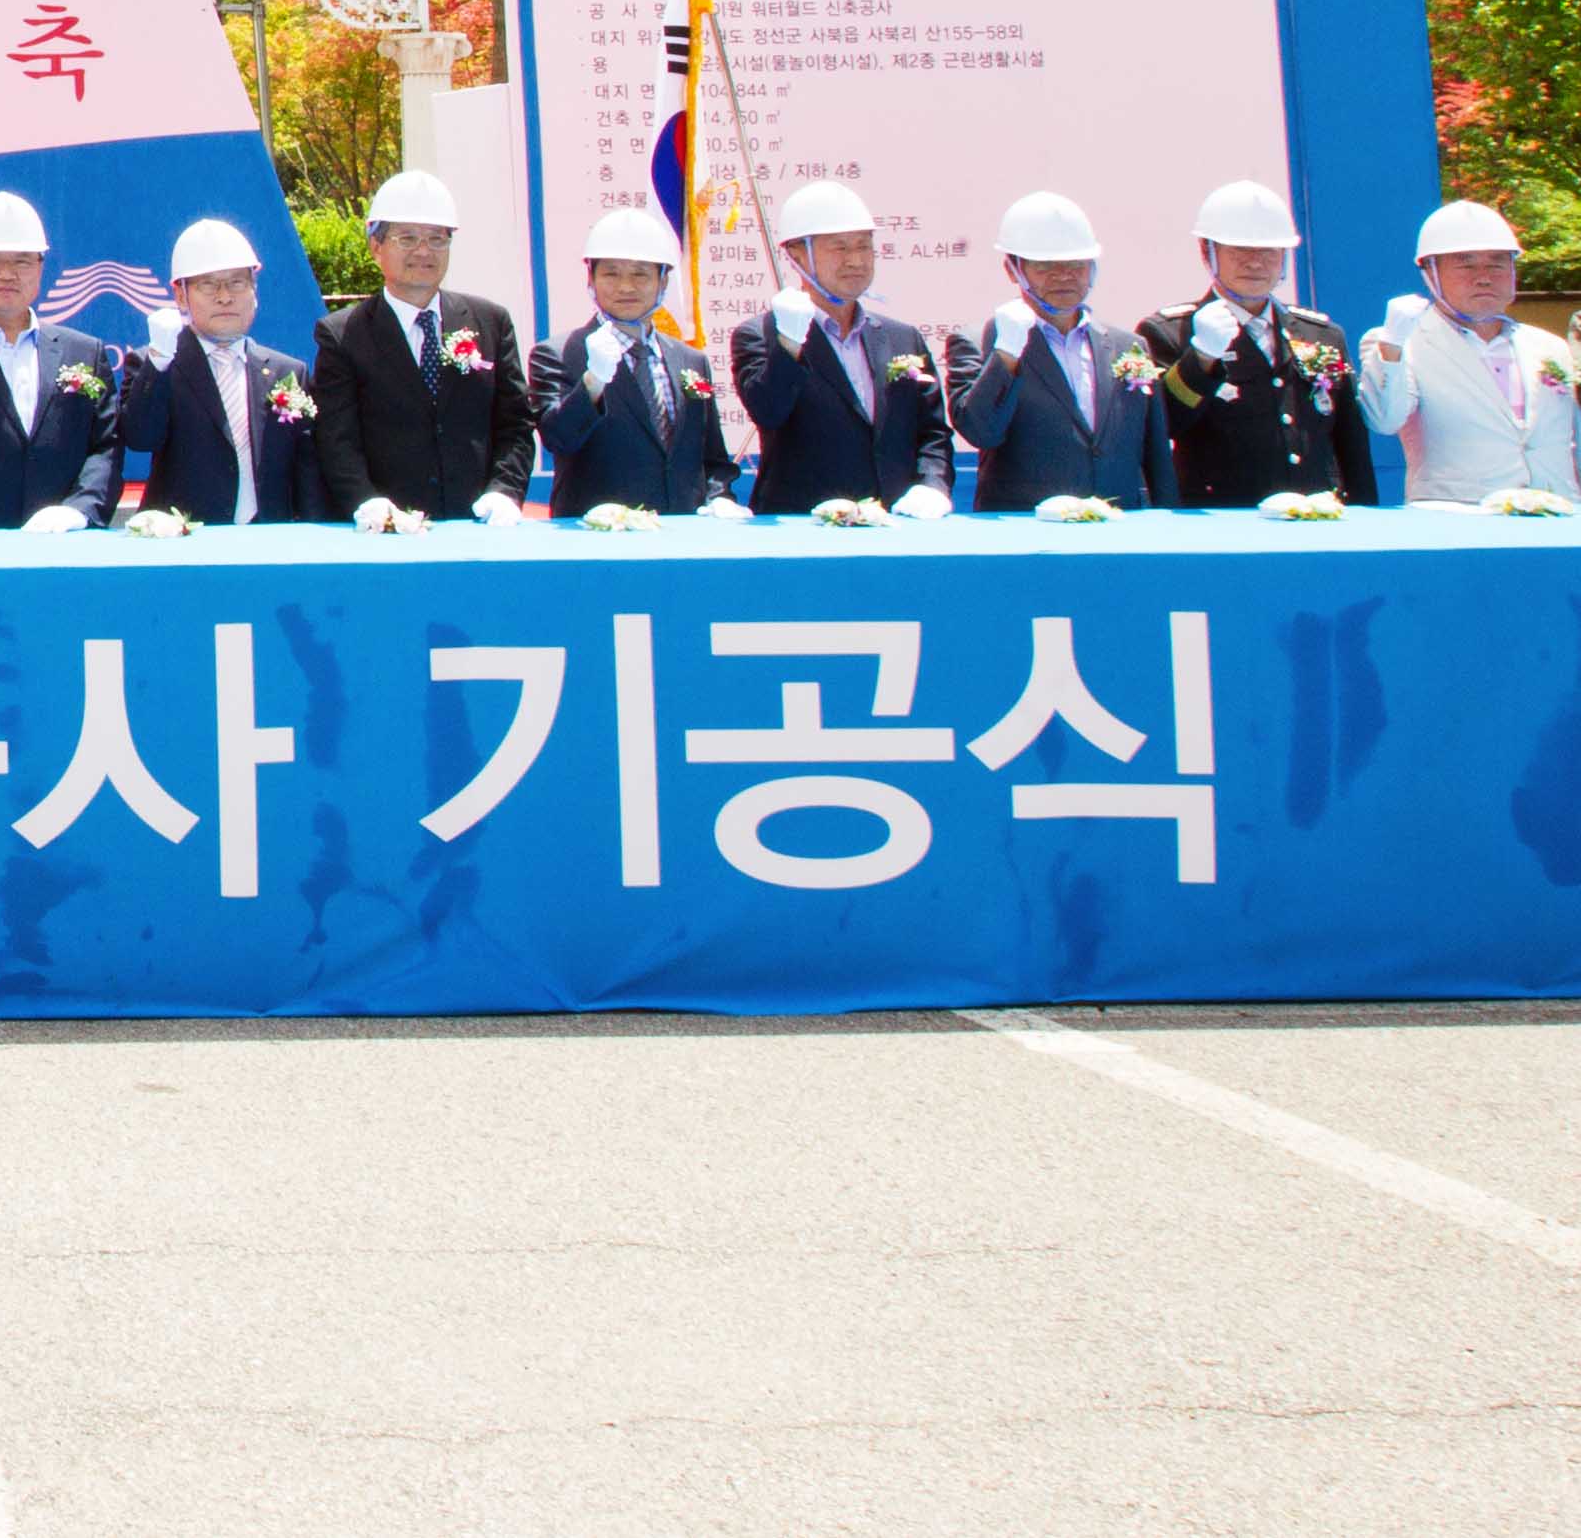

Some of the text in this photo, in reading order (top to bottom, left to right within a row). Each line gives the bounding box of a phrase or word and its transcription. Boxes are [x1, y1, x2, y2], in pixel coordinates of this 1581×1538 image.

[751, 0, 818, 17] 워터월드
[825, 0, 892, 17] 신축공사
[591, 30, 624, 46] 대지
[753, 28, 802, 45] 정선군
[810, 26, 861, 45] 사북읍
[867, 25, 916, 43] 사북리
[7, 4, 104, 102] 축
[592, 56, 608, 74] 용
[893, 52, 936, 70] 제2종
[942, 50, 1045, 69] 근린생활시설
[595, 83, 628, 100] 대지
[597, 110, 630, 127] 건축
[597, 137, 613, 155] 연
[599, 164, 614, 182] 층
[795, 162, 828, 180] 지하
[835, 161, 861, 179] 4층
[709, 246, 757, 262] 알미늄
[707, 272, 765, 290] 47,947
[423, 612, 1215, 888] 기공식
